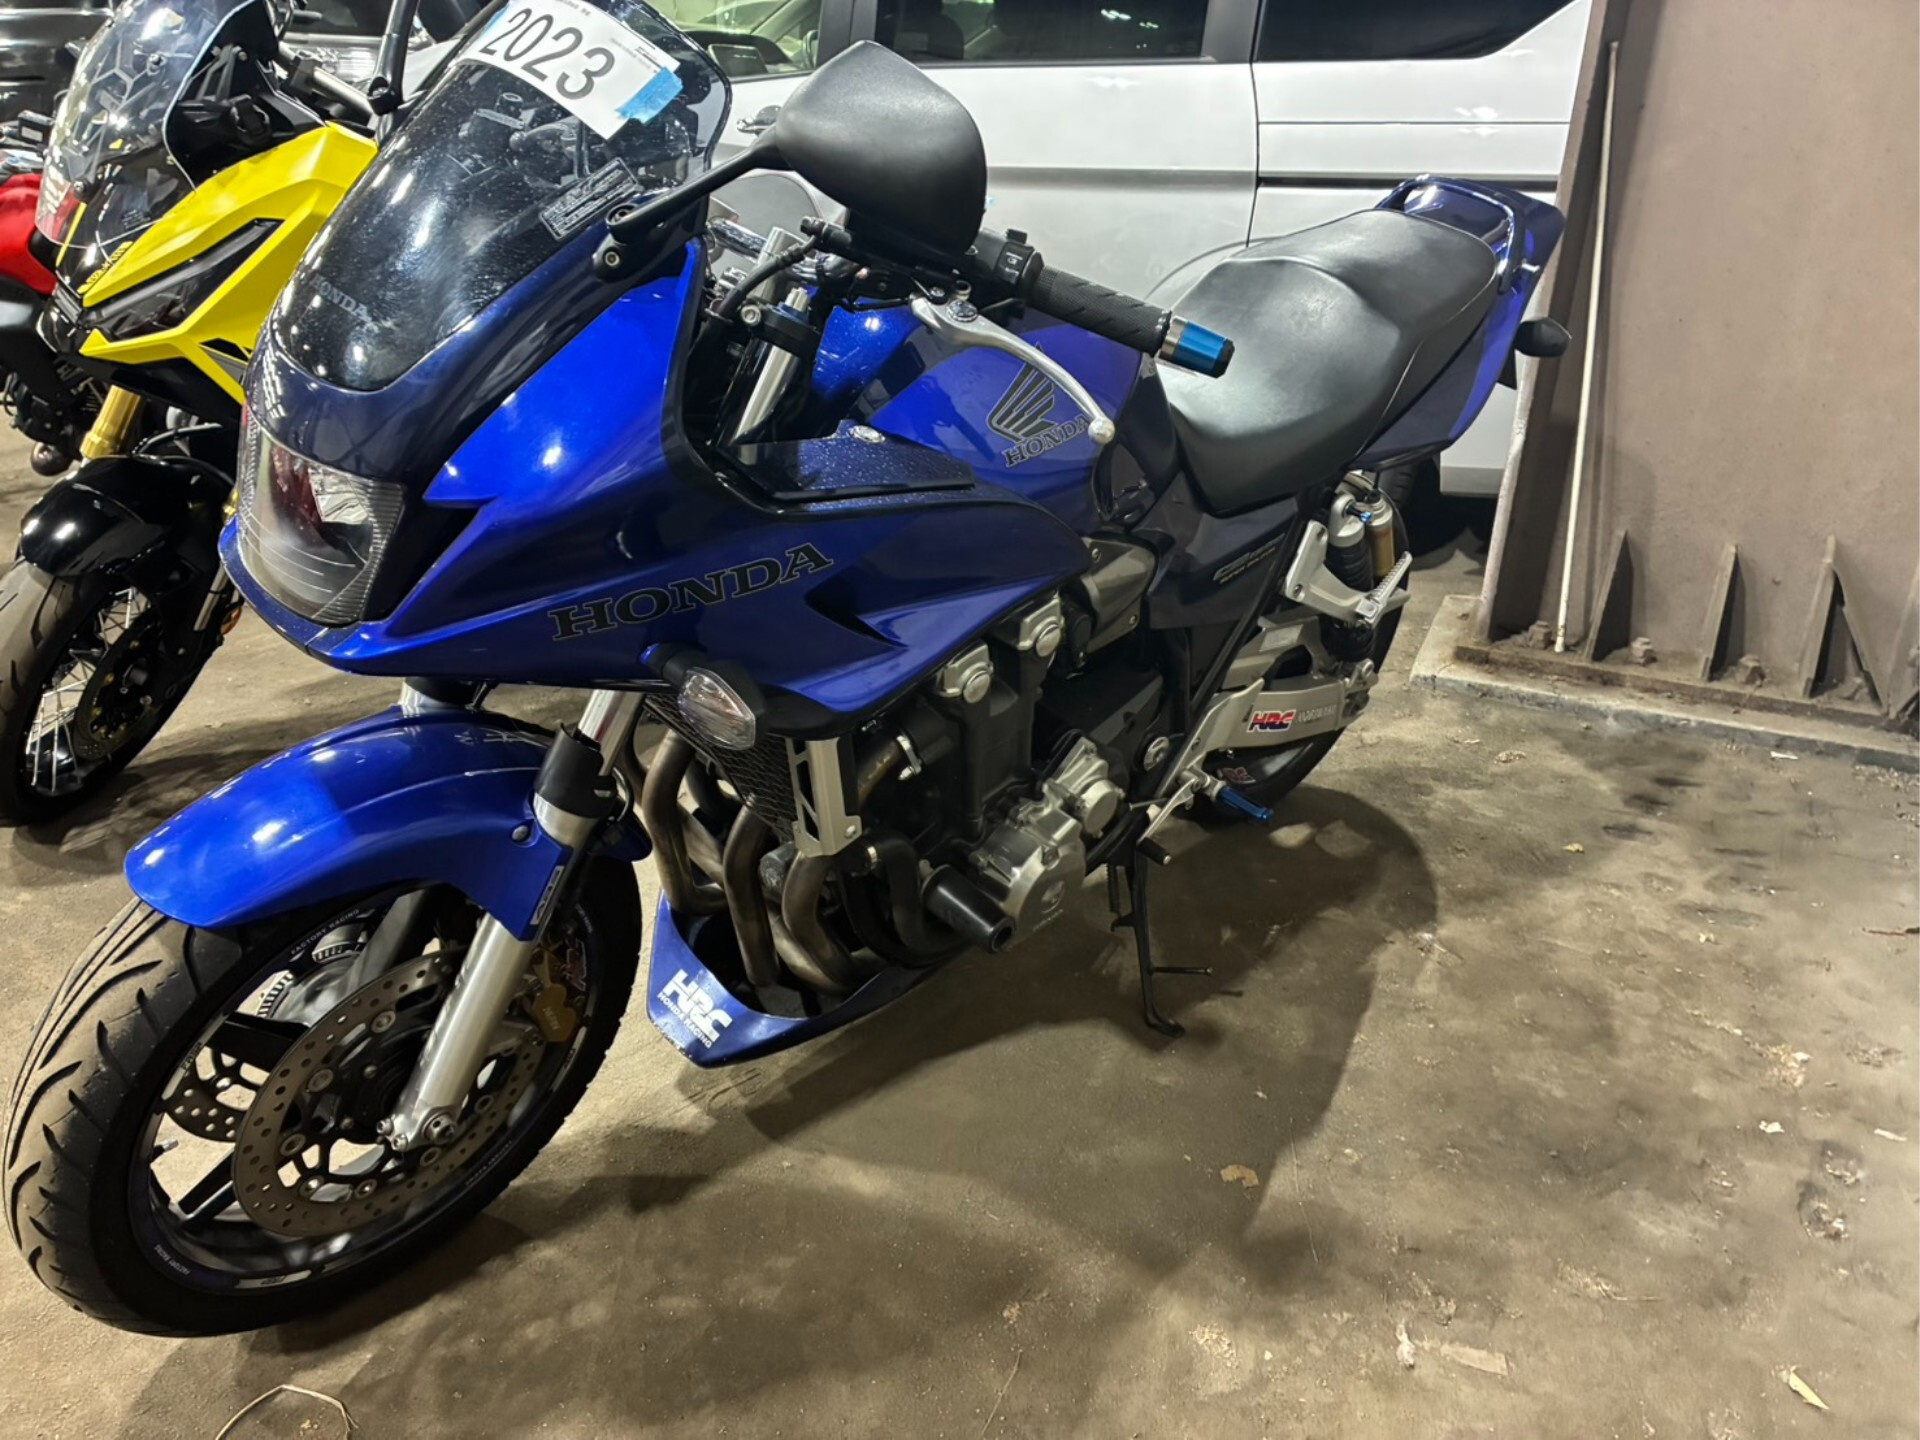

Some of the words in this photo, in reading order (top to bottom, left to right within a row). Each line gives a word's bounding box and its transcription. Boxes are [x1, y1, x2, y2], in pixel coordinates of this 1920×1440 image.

[479, 7, 615, 100] 2023
[309, 274, 374, 323] HONDA
[1001, 414, 1090, 468] HONDA
[547, 542, 835, 641] HONDA
[1246, 710, 1297, 733] HRC
[290, 927, 327, 955] FACTORY
[657, 990, 685, 1021] HONDA
[683, 1017, 713, 1049] RACING
[663, 968, 733, 1043] HRC
